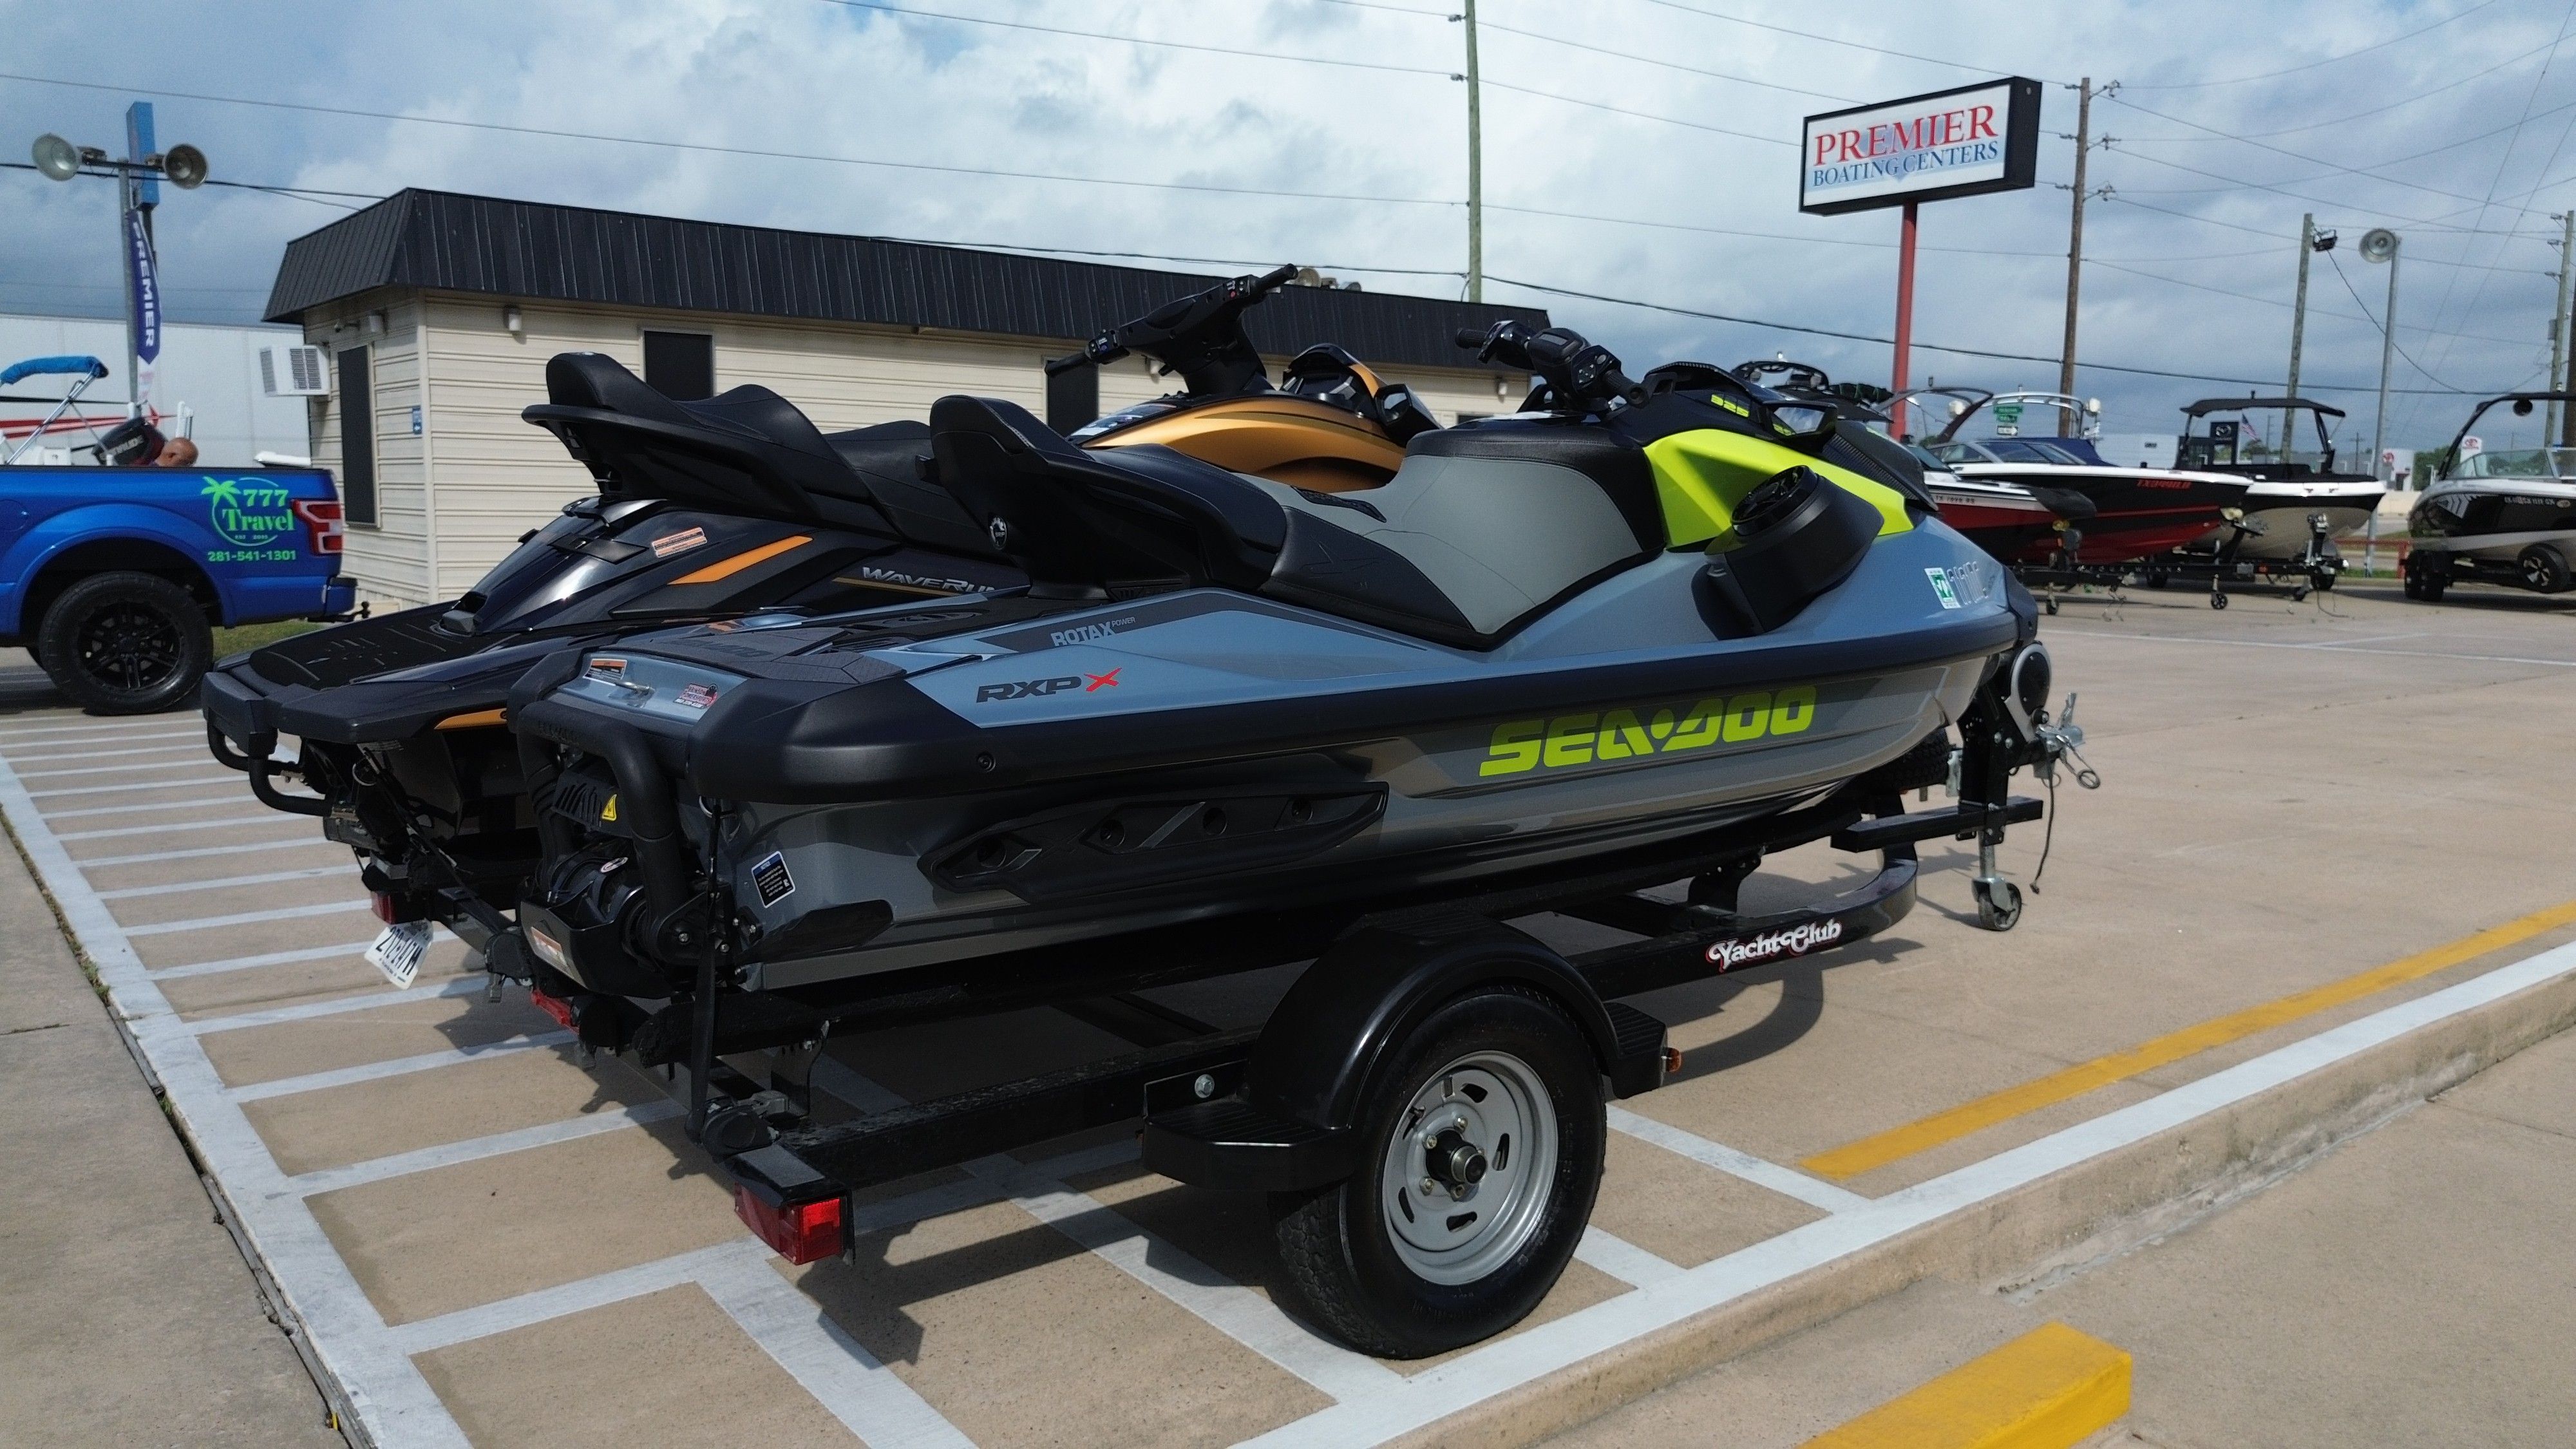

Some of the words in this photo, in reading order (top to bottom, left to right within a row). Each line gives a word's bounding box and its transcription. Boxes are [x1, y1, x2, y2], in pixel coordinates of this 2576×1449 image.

[1814, 105, 1998, 167] PREMIER
[1813, 158, 1899, 187] BOATING
[1903, 141, 1998, 173] CENTERS
[243, 489, 289, 507] 777
[222, 508, 296, 531] Travel
[207, 550, 296, 562] 281-541-1301
[1050, 621, 1117, 647] ROTAX
[1112, 616, 1136, 627] POWER
